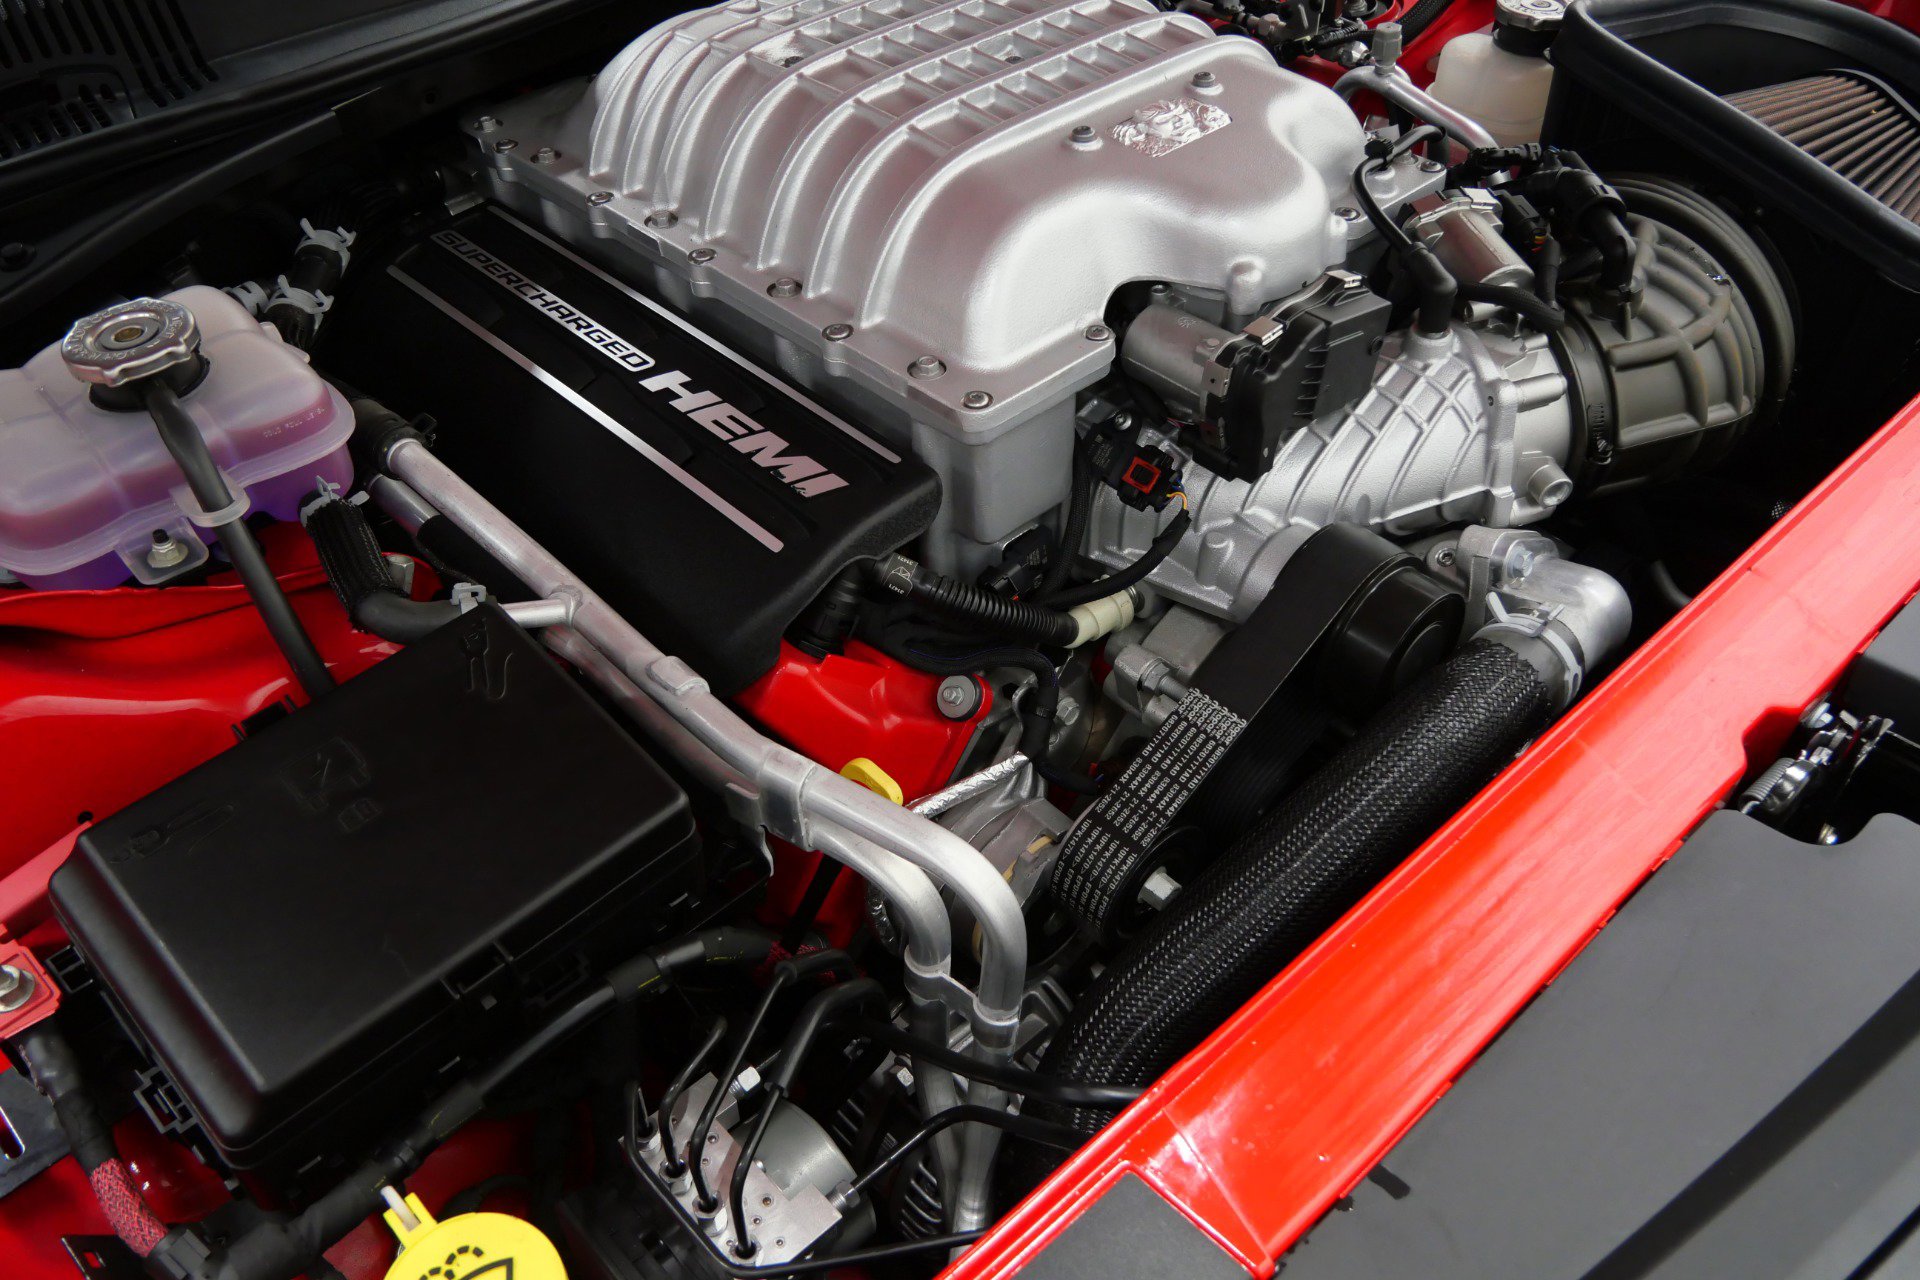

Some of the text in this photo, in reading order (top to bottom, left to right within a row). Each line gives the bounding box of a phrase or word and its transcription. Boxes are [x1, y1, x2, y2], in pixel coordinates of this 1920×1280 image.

[437, 231, 850, 498] SUPERCHARGED HEMI
[1141, 714, 1179, 757] 68207171AD
[1151, 720, 1188, 763] 68207171AD
[1160, 727, 1197, 770] 68207171AD
[1169, 733, 1207, 776] 68207171AD
[1178, 739, 1216, 783] 68207171AD
[1187, 745, 1225, 789] 68207171AD
[1118, 757, 1143, 784] 83044X
[1128, 763, 1152, 791] 83044X
[1137, 770, 1162, 797] 83044X
[1094, 783, 1121, 813] 21-2652
[1104, 790, 1131, 821] 21-2652
[1146, 776, 1171, 804] 83044X
[1155, 783, 1180, 811] 83044X
[1164, 789, 1189, 817] 83044X
[1113, 797, 1140, 827] 21-2652
[1122, 803, 1148, 834] 21-2652
[1131, 810, 1158, 841] 21-2652
[1139, 817, 1167, 847] 21-2652
